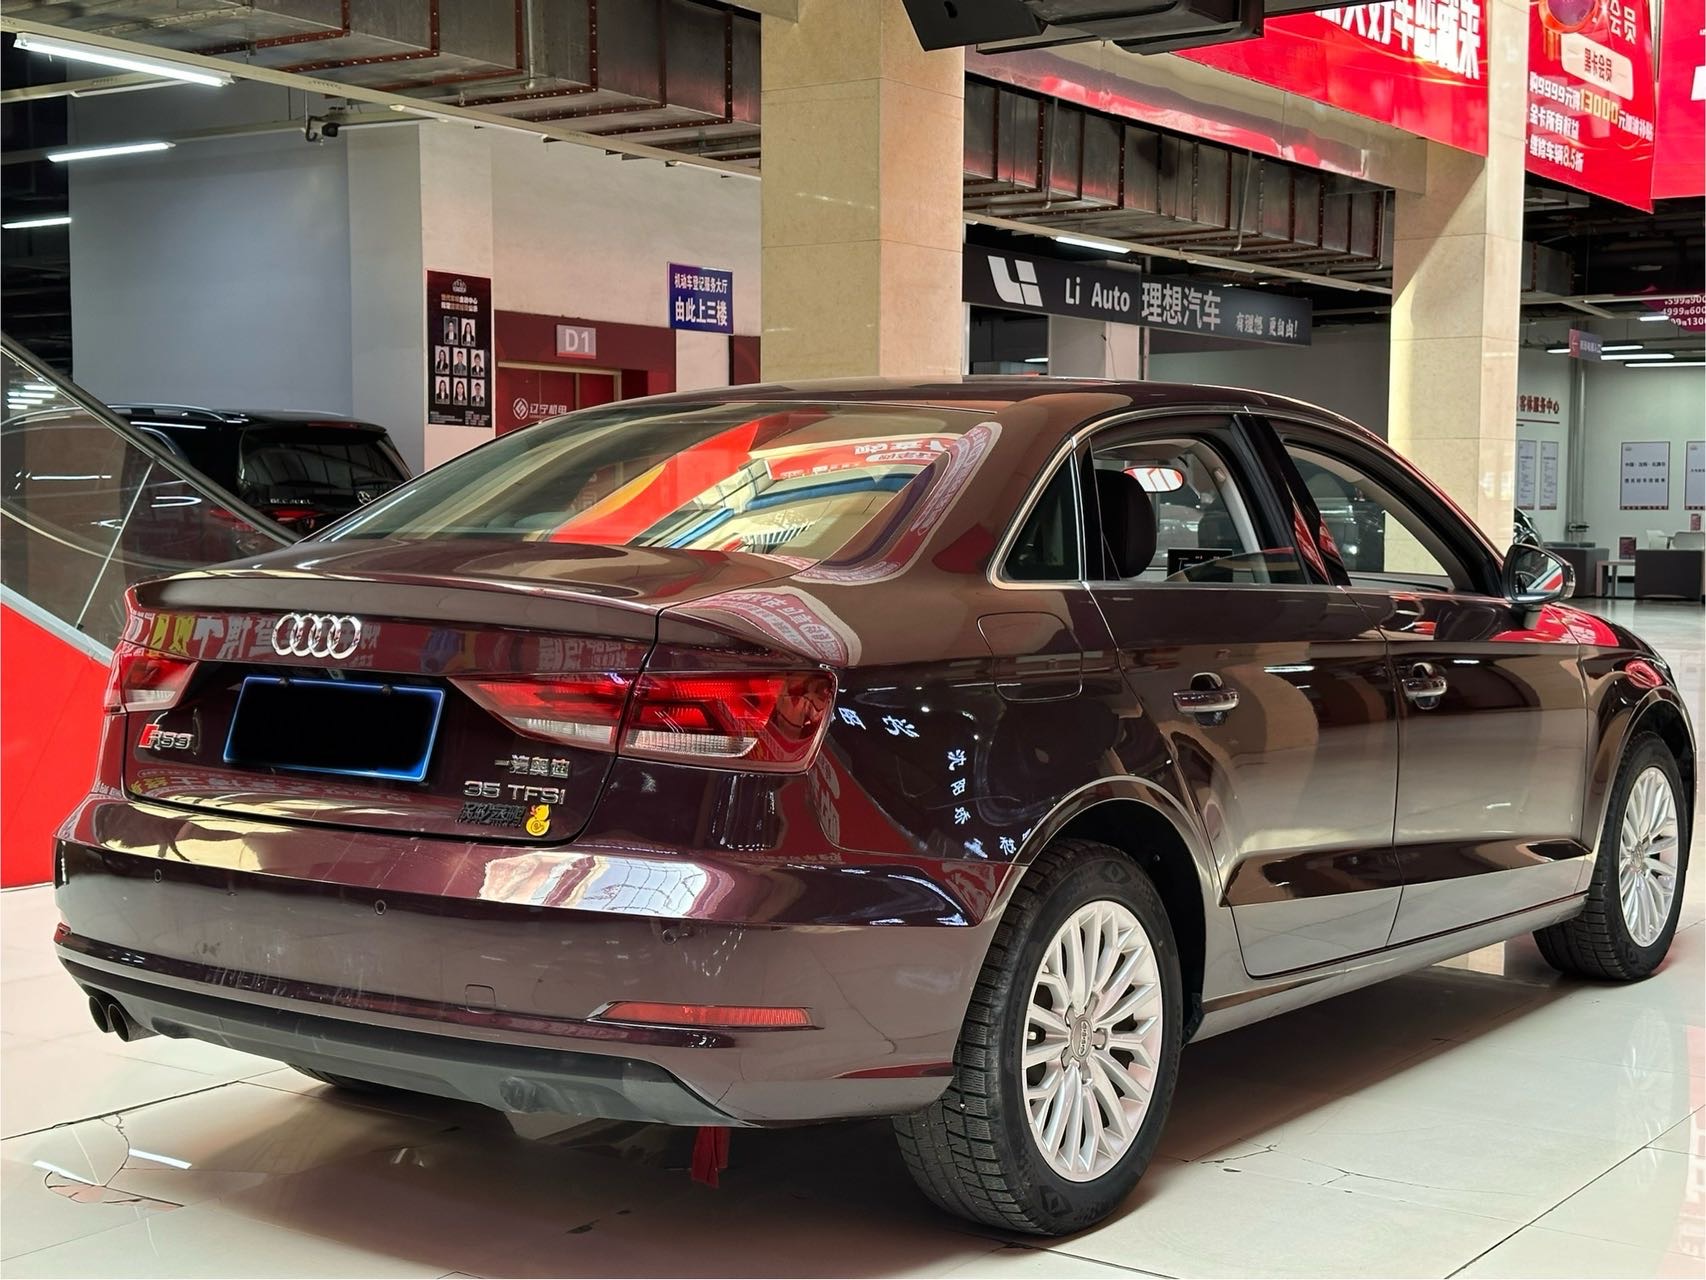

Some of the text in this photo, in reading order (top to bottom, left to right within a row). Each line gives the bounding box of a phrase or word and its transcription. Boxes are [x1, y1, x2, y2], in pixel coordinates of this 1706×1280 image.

[674, 273, 728, 294] 机动车登记服务大厅
[675, 296, 728, 326] 由此上三楼
[1065, 277, 1222, 331] Li Auto 理想汽车
[565, 328, 590, 353] D1
[529, 403, 567, 415] 辽宁机电
[463, 780, 566, 805] 35 TFSI
